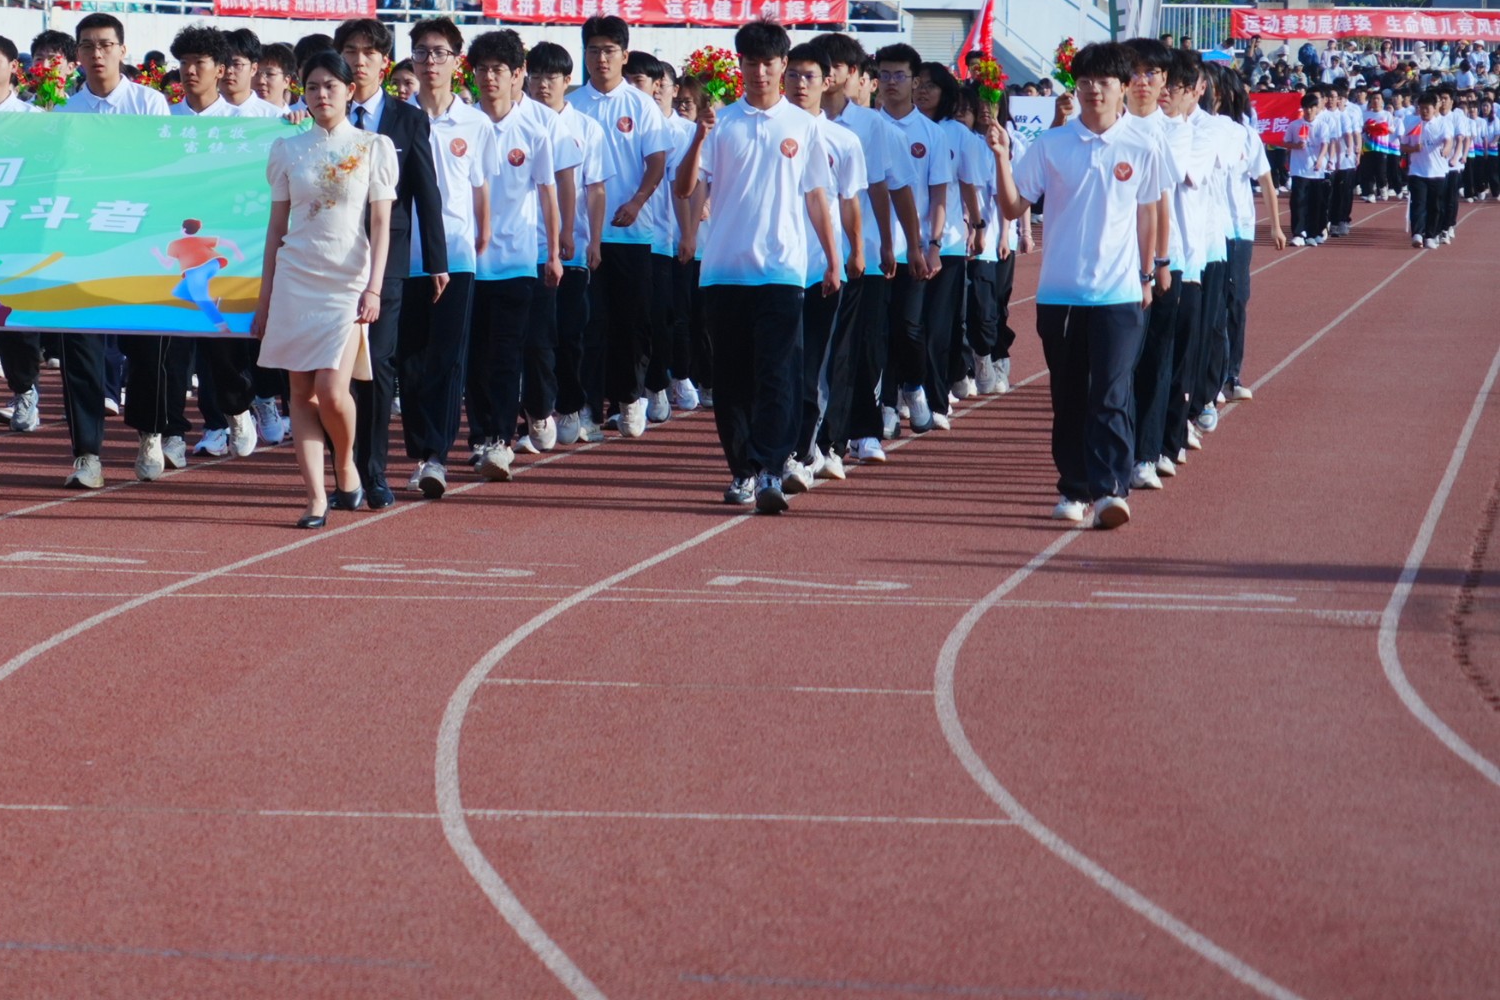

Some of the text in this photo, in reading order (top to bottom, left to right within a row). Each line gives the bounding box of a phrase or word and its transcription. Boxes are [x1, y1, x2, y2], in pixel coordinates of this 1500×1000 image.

[1242, 13, 1372, 35] 运动赛场展雄姿
